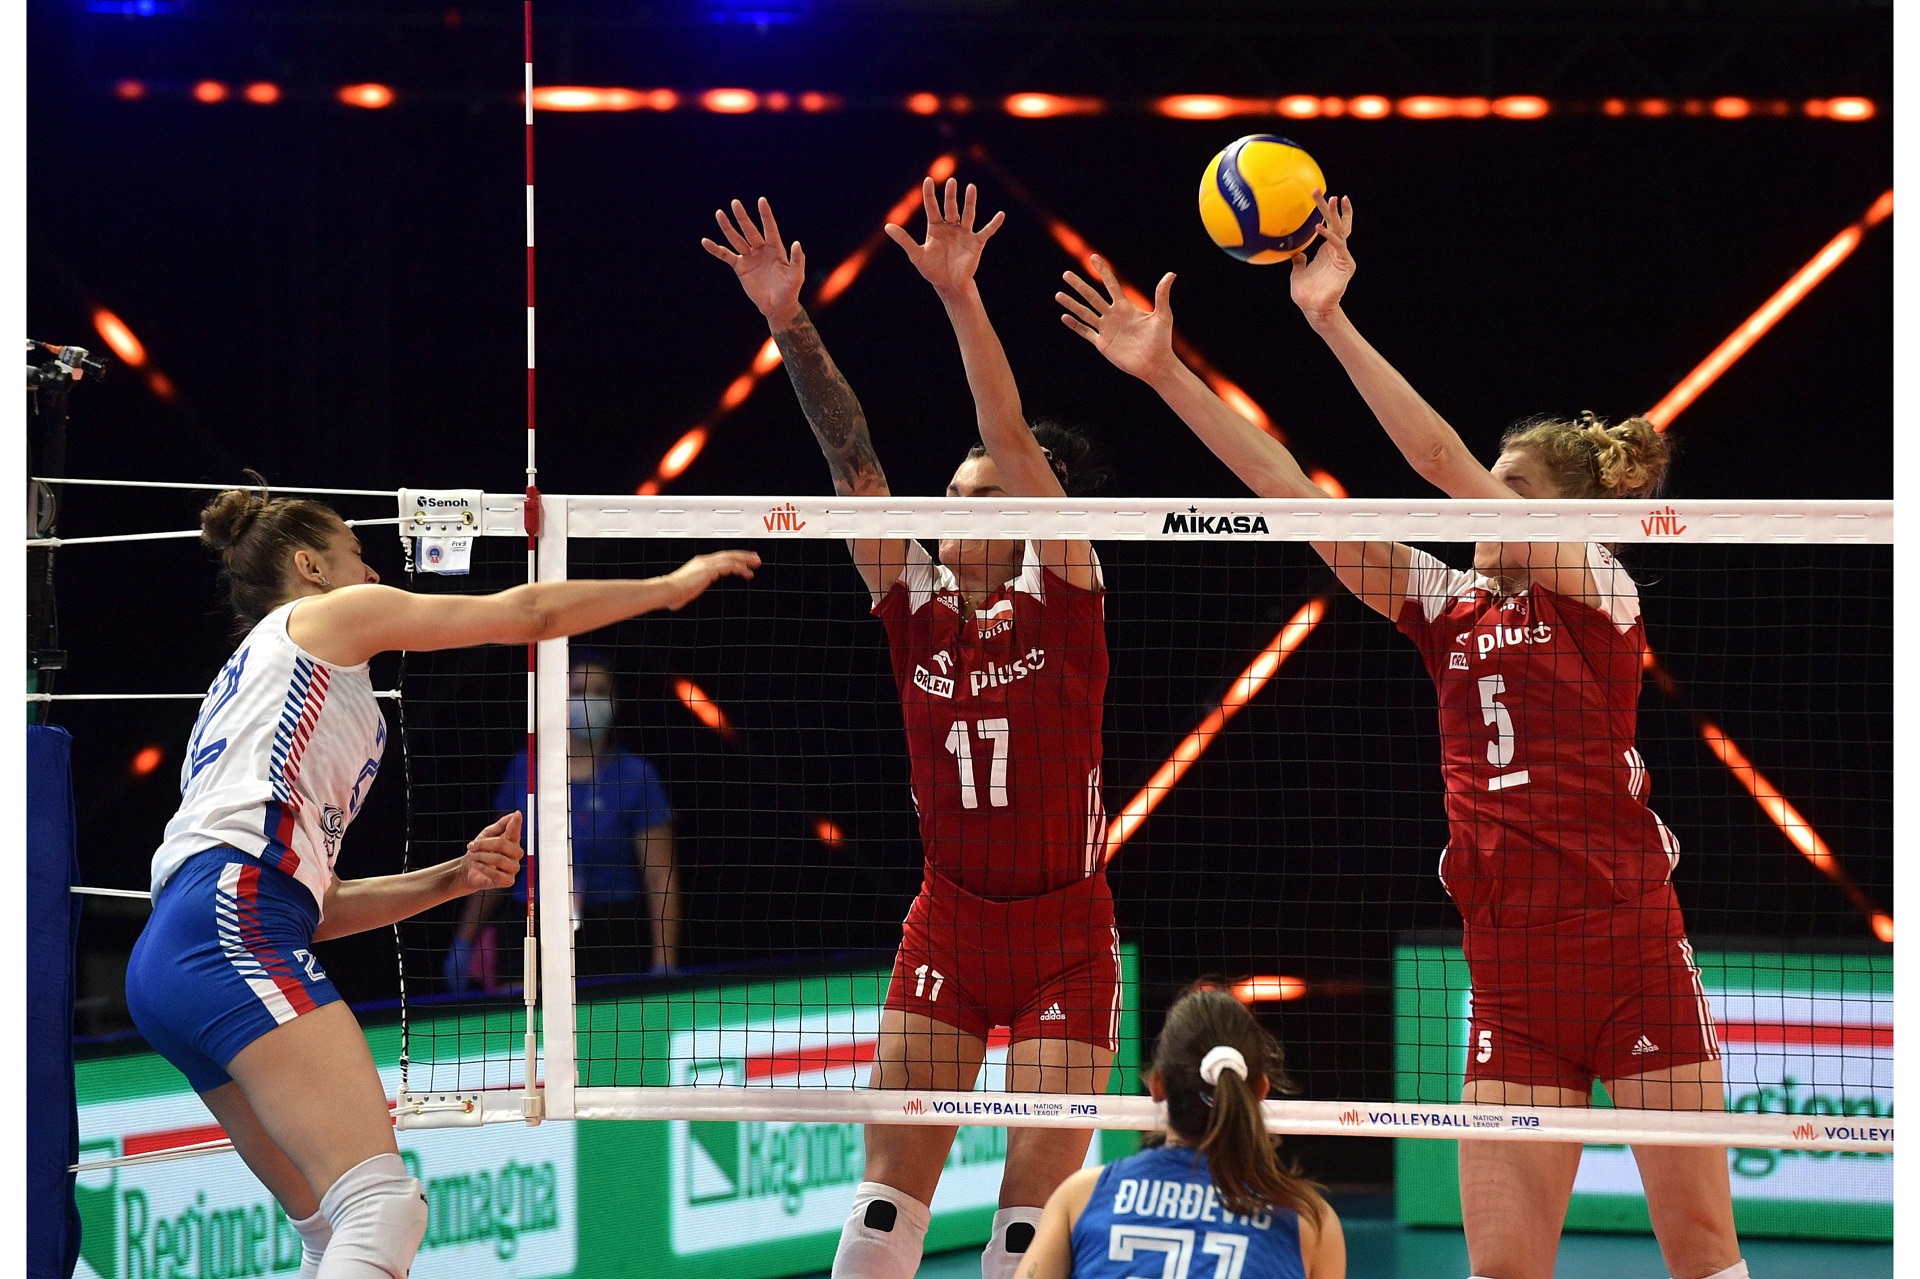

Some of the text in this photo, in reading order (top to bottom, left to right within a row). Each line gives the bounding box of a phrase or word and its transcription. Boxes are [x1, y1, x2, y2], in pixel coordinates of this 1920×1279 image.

[428, 498, 469, 507] Senoh
[763, 502, 806, 533] VNL
[1162, 507, 1269, 534] MIKASA
[1641, 506, 1687, 536] VNL
[1478, 624, 1532, 660] plus
[915, 669, 951, 695] ORLEN
[970, 660, 1028, 697] plus
[1478, 674, 1514, 768] 5
[944, 718, 1010, 809] 17
[292, 949, 326, 981] 2
[914, 964, 945, 1002] 17
[1040, 1013, 1066, 1021] adidas
[1476, 1030, 1493, 1063] 5
[932, 1101, 1031, 1115] VOLLEYBALL
[1070, 1104, 1097, 1114] FIVB
[1368, 1112, 1470, 1127] VOLLEYBALL
[1511, 1116, 1539, 1127] FIVB
[1825, 1126, 1893, 1141] VOLLEY
[1113, 1178, 1274, 1231] ĐURĐE
